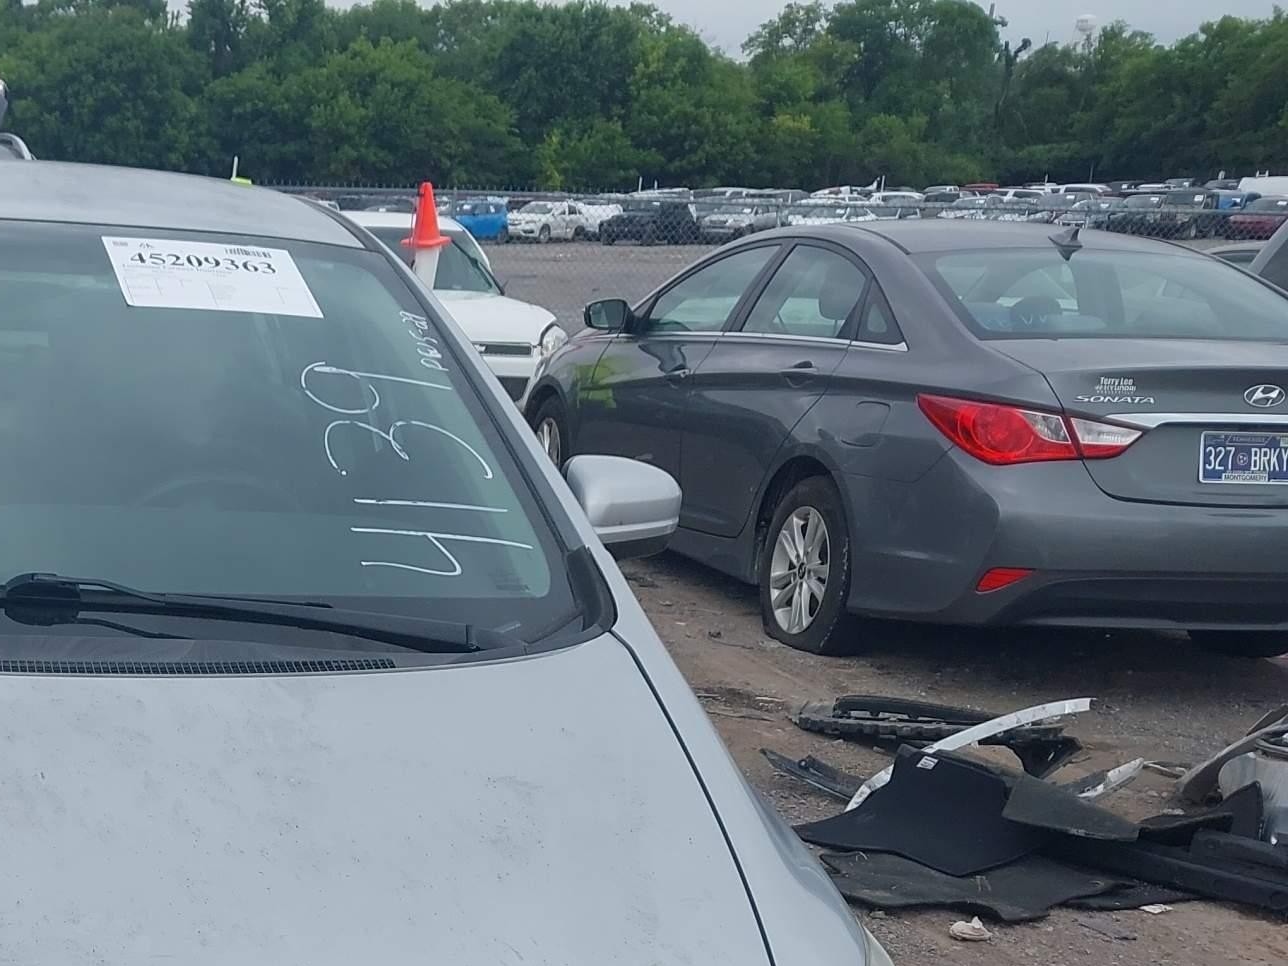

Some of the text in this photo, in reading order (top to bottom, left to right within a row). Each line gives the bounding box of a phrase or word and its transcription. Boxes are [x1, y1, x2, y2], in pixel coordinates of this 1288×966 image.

[130, 251, 277, 275] 45209363
[1100, 376, 1134, 386] Terry Lee
[1073, 395, 1155, 405] SONATA
[1205, 446, 1288, 472] 327 BRKY
[1223, 474, 1267, 482] MONTGOMERY
